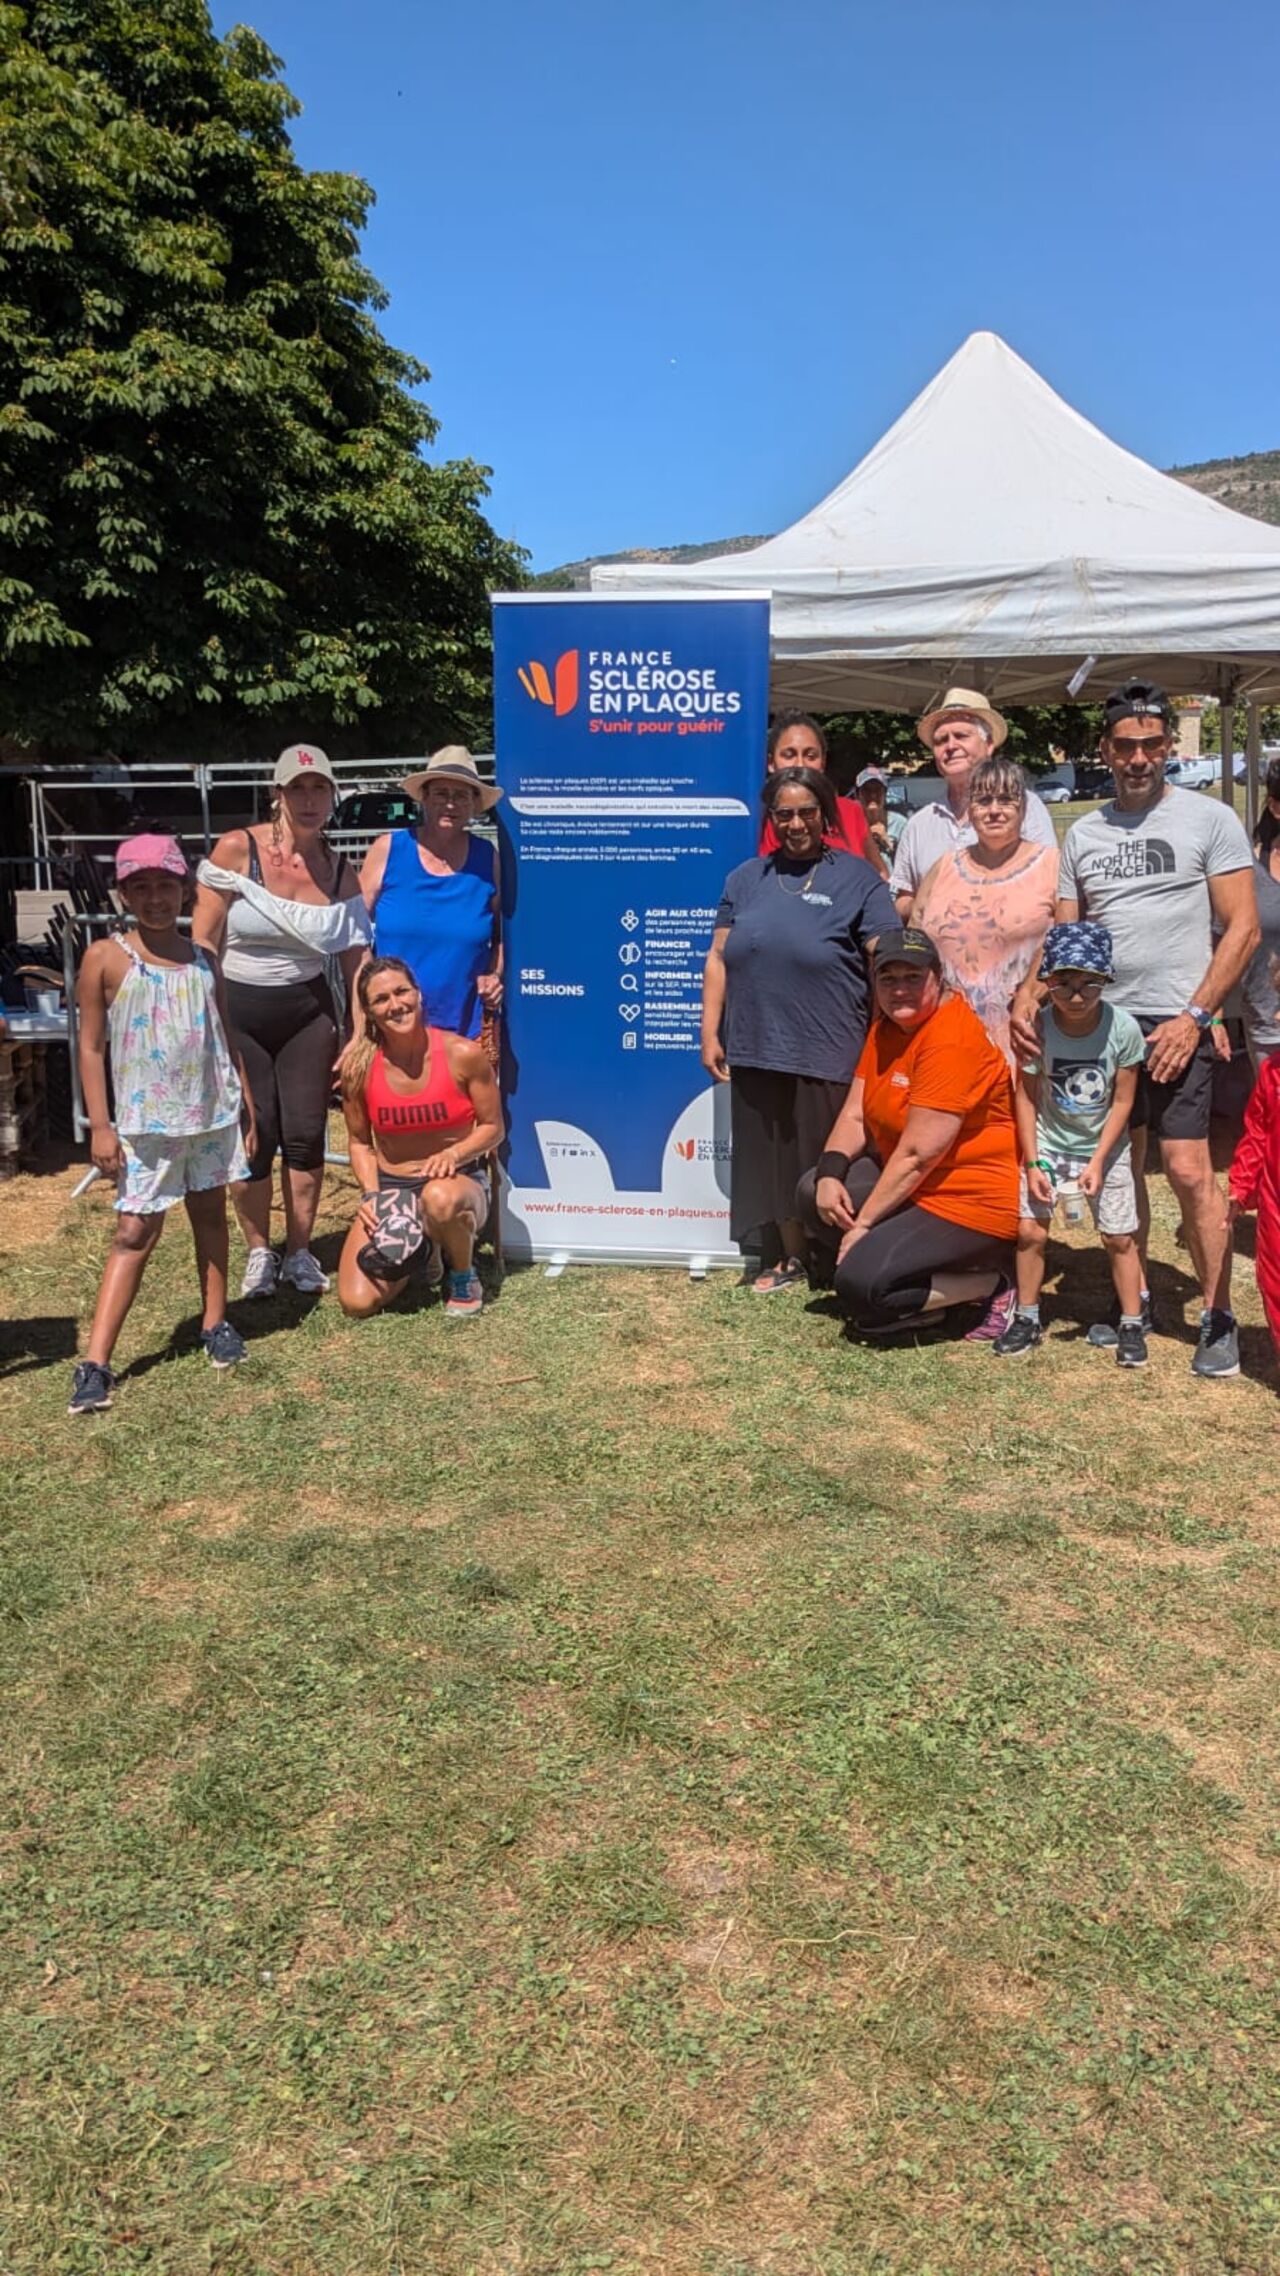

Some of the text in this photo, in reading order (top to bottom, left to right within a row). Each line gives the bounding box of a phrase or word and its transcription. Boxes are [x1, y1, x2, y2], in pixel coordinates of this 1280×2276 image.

[589, 651, 673, 666] FRANCE
[588, 665, 717, 691] SCLÉROSE
[588, 692, 741, 718] EN PLAQUES
[589, 718, 726, 736] S'unir pour guérir
[1116, 840, 1146, 855] THE
[1091, 852, 1146, 871] NORTH
[1104, 864, 1146, 880] FACE
[644, 909, 668, 917] AGIR
[669, 909, 689, 917] AUX
[644, 940, 691, 948] FINANCER
[520, 968, 545, 980] SES
[644, 971, 692, 979] INFORMER
[520, 983, 585, 997] MISSIONS
[643, 1032, 694, 1041] MOBILISER
[377, 1102, 449, 1127] PUMA
